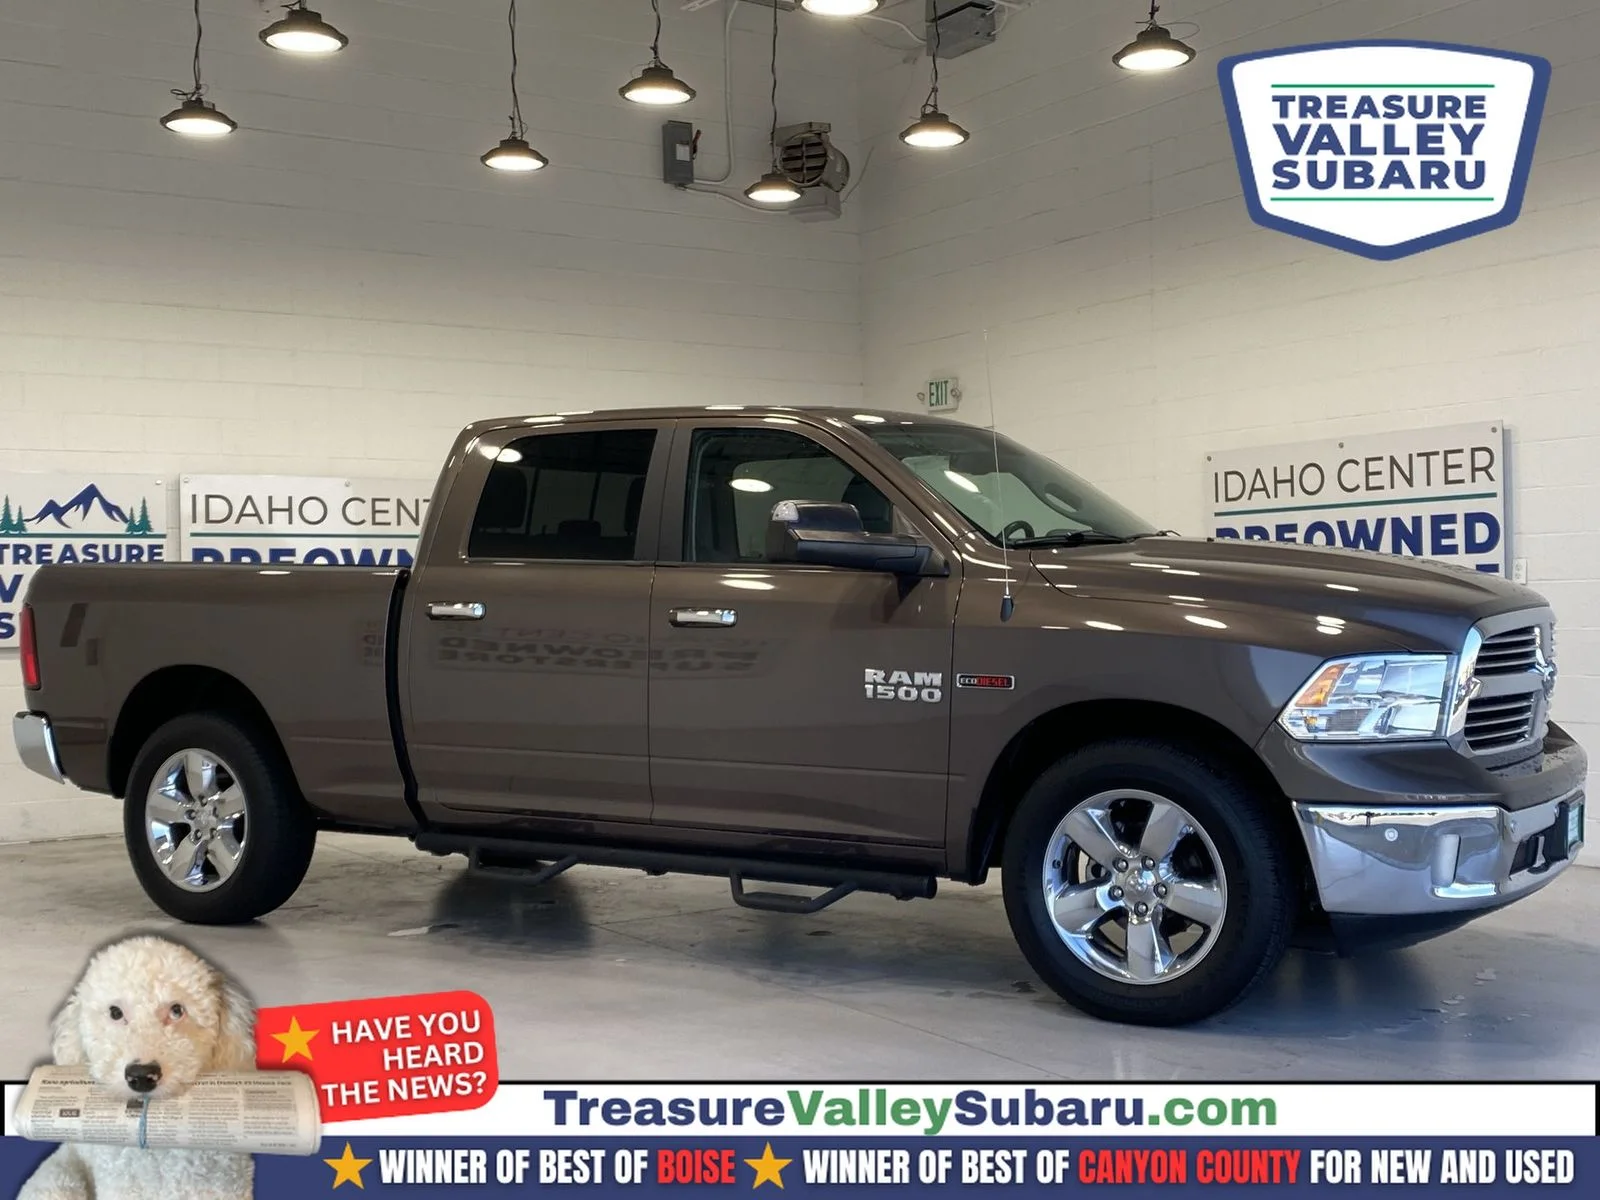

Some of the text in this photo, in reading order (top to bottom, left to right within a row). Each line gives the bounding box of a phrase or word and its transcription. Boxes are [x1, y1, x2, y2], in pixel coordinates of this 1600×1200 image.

[929, 380, 948, 407] EXIT
[1214, 446, 1496, 503] IDAHO CENTER
[191, 494, 430, 526] IDAHO CEN
[864, 668, 943, 687] RAM
[864, 684, 943, 703] 1500
